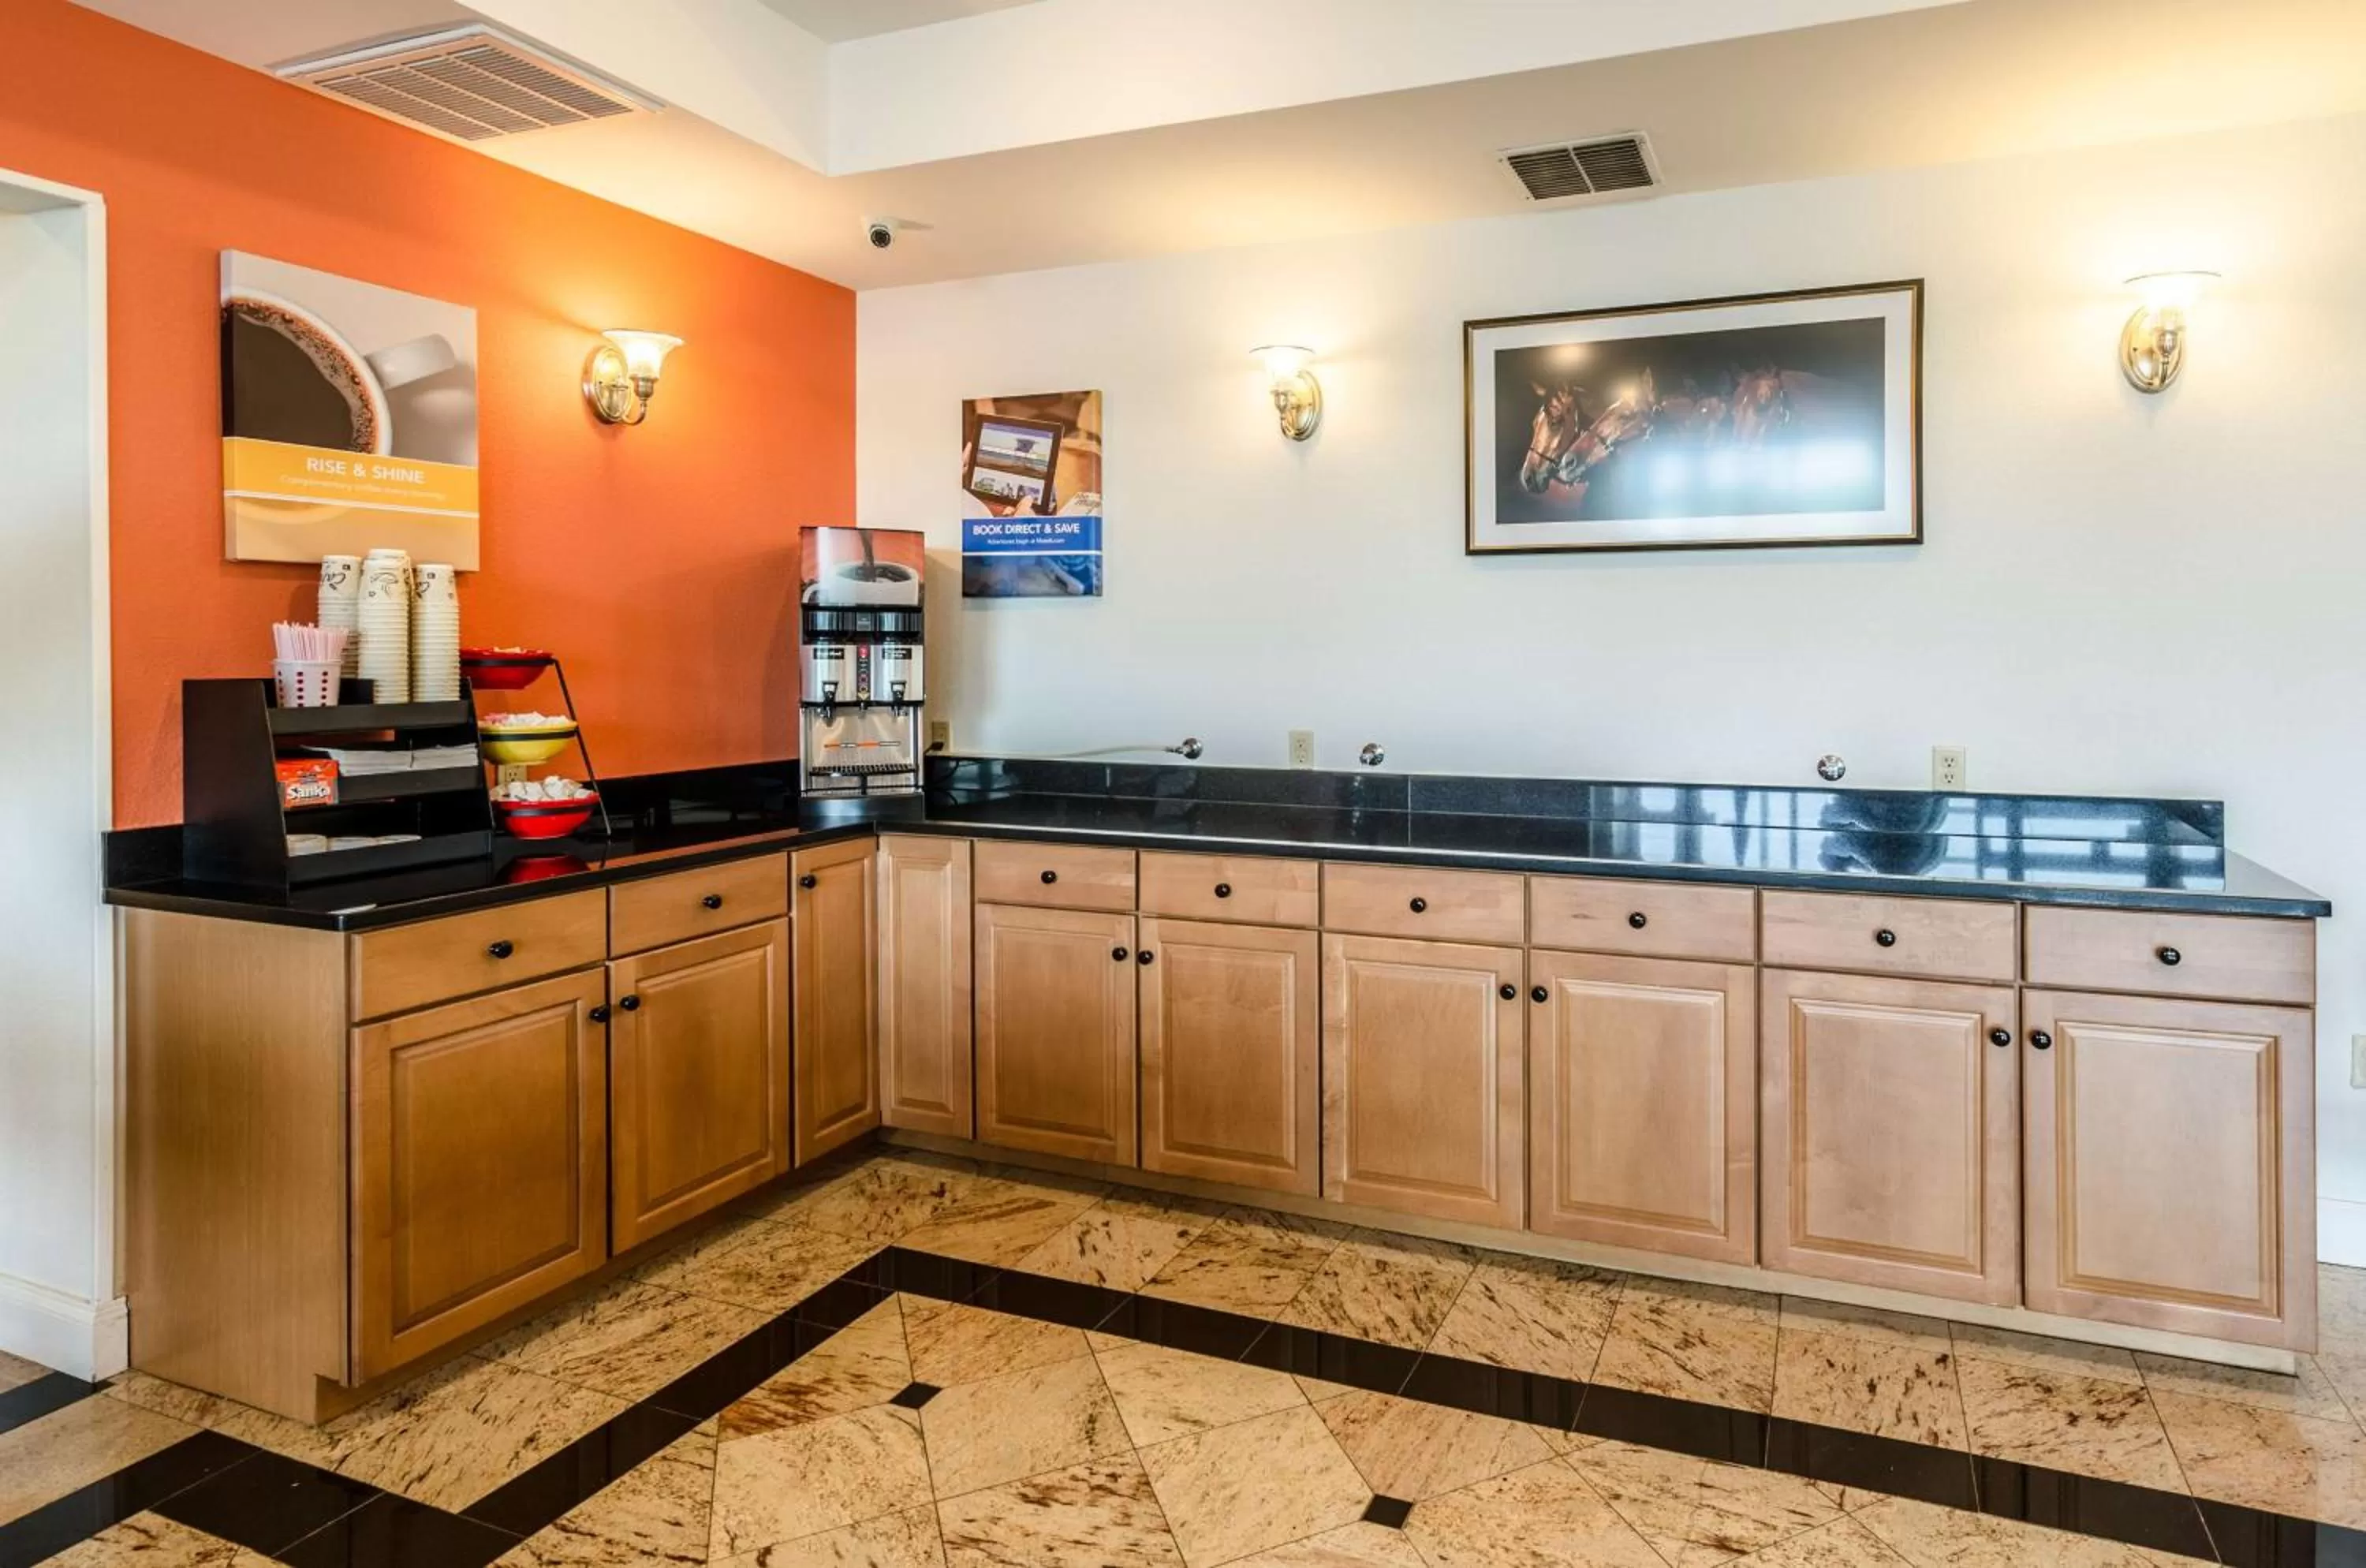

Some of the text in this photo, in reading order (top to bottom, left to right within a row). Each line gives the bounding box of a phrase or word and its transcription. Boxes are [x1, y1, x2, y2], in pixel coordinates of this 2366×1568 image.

[306, 457, 347, 475] RISE
[353, 462, 366, 478] &
[371, 464, 425, 484] SHINE
[972, 523, 1080, 536] BOOK DIRECT & SAVE
